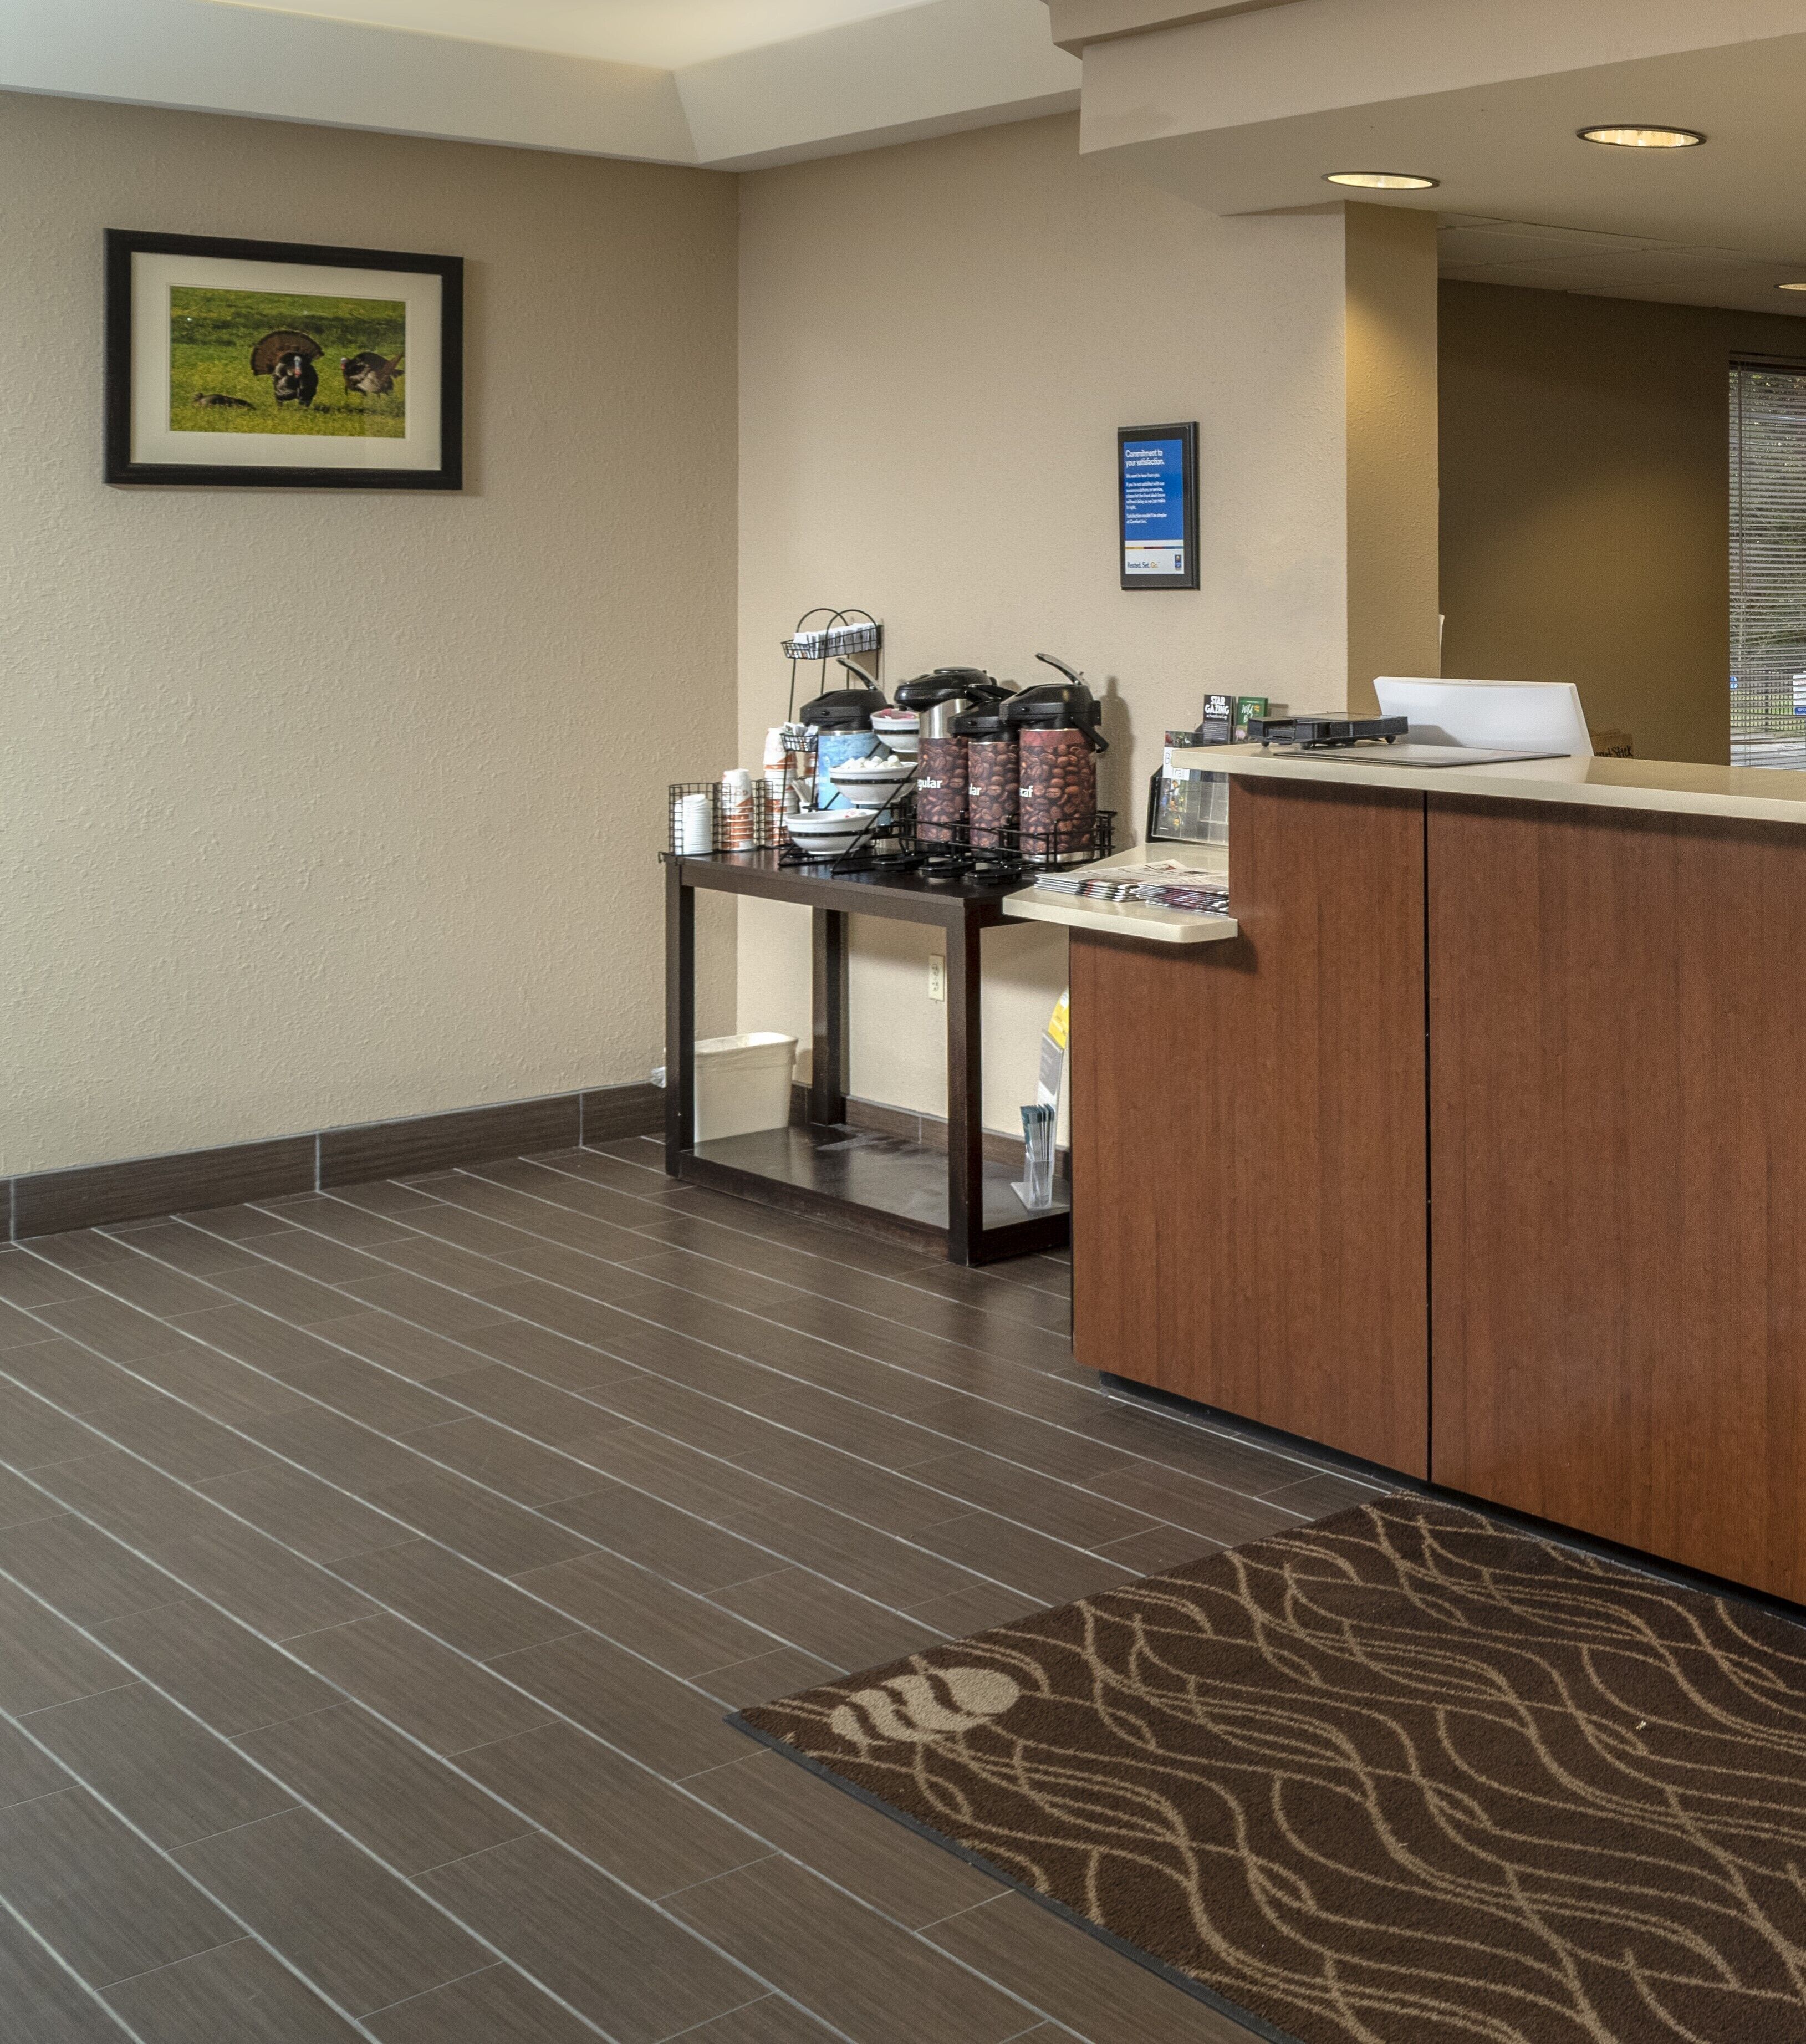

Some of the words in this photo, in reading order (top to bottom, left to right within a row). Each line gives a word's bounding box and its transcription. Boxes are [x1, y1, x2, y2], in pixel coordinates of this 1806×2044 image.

[1211, 696, 1225, 705] STAR
[1205, 704, 1229, 715] GAZING
[917, 776, 943, 791] gular
[969, 783, 982, 796] lar
